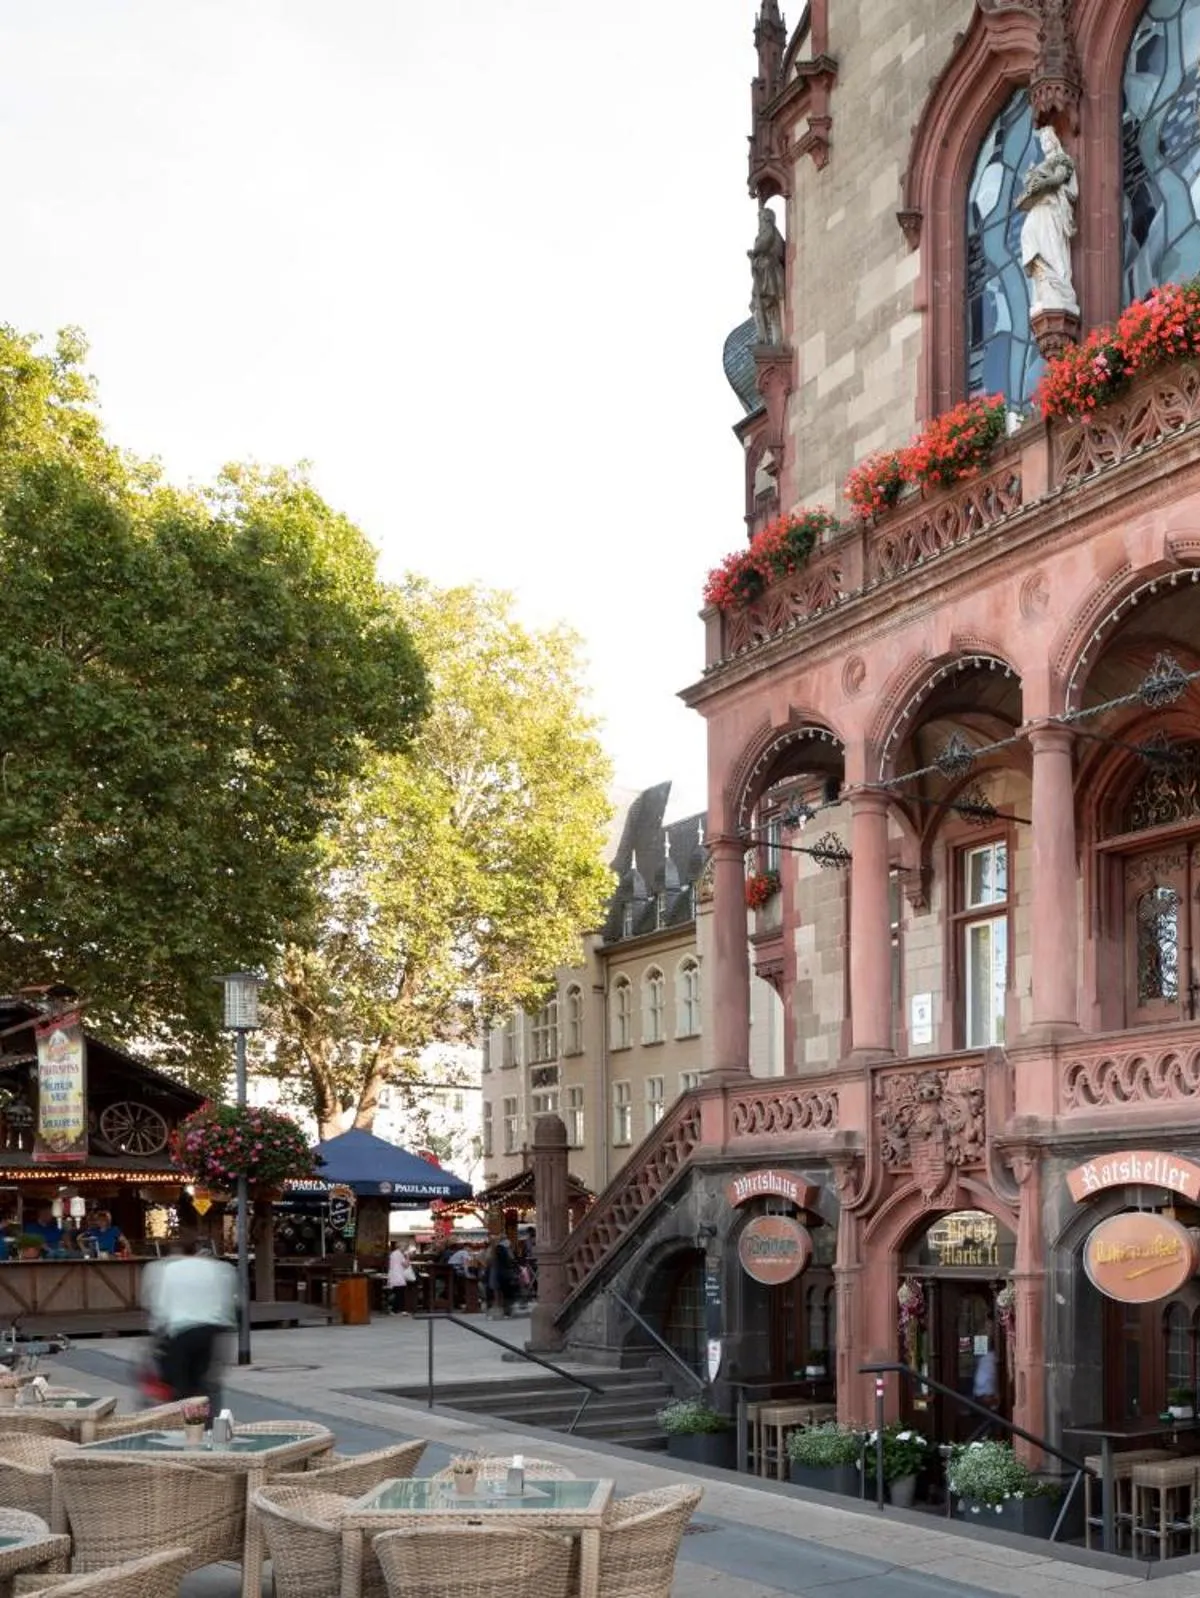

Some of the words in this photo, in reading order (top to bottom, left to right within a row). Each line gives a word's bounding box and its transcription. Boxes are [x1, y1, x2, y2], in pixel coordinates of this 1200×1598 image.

[733, 1171, 798, 1199] Wirtshaus
[1081, 1154, 1191, 1192] Ratskeller
[394, 1183, 451, 1195] PAULANER
[939, 1244, 982, 1267] Markt
